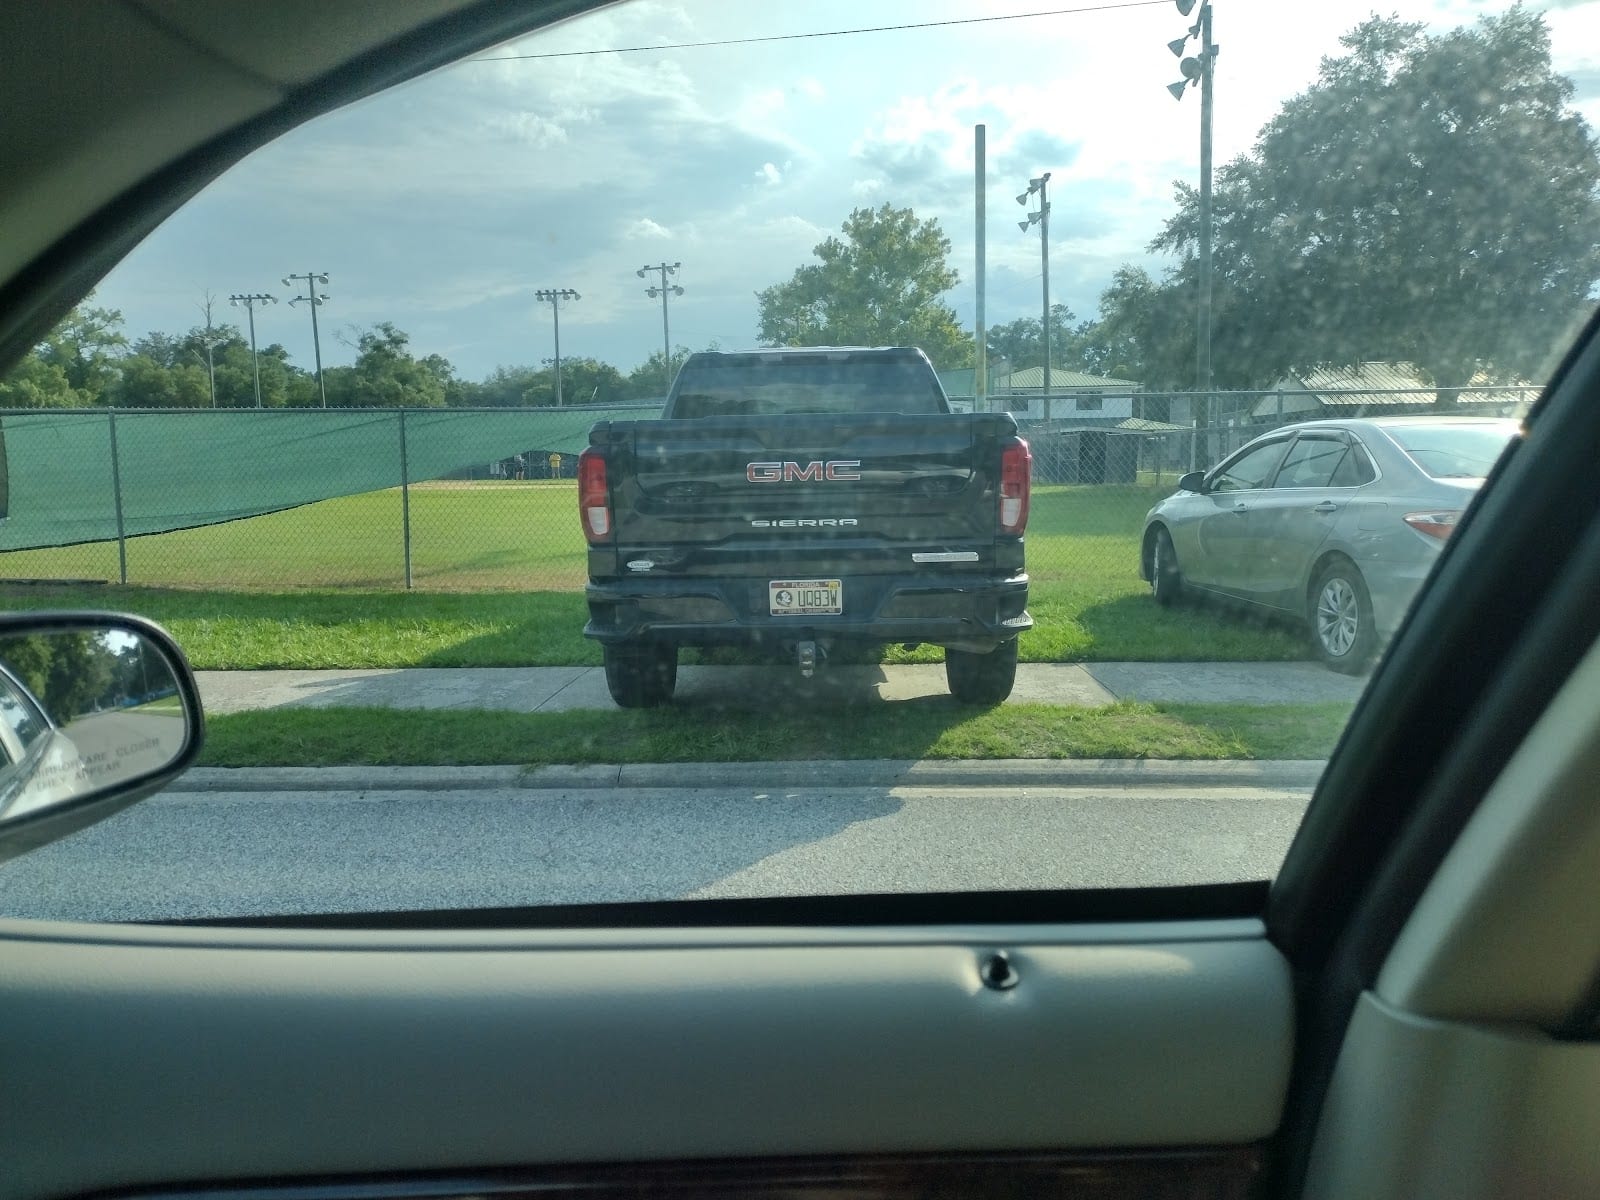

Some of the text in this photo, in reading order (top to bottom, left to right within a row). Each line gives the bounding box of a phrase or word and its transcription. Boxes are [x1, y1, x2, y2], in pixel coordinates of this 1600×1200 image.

[746, 460, 861, 483] GMC
[751, 518, 858, 528] SIERRA
[797, 590, 838, 607] UQ83W
[115, 737, 160, 757] CLOSER
